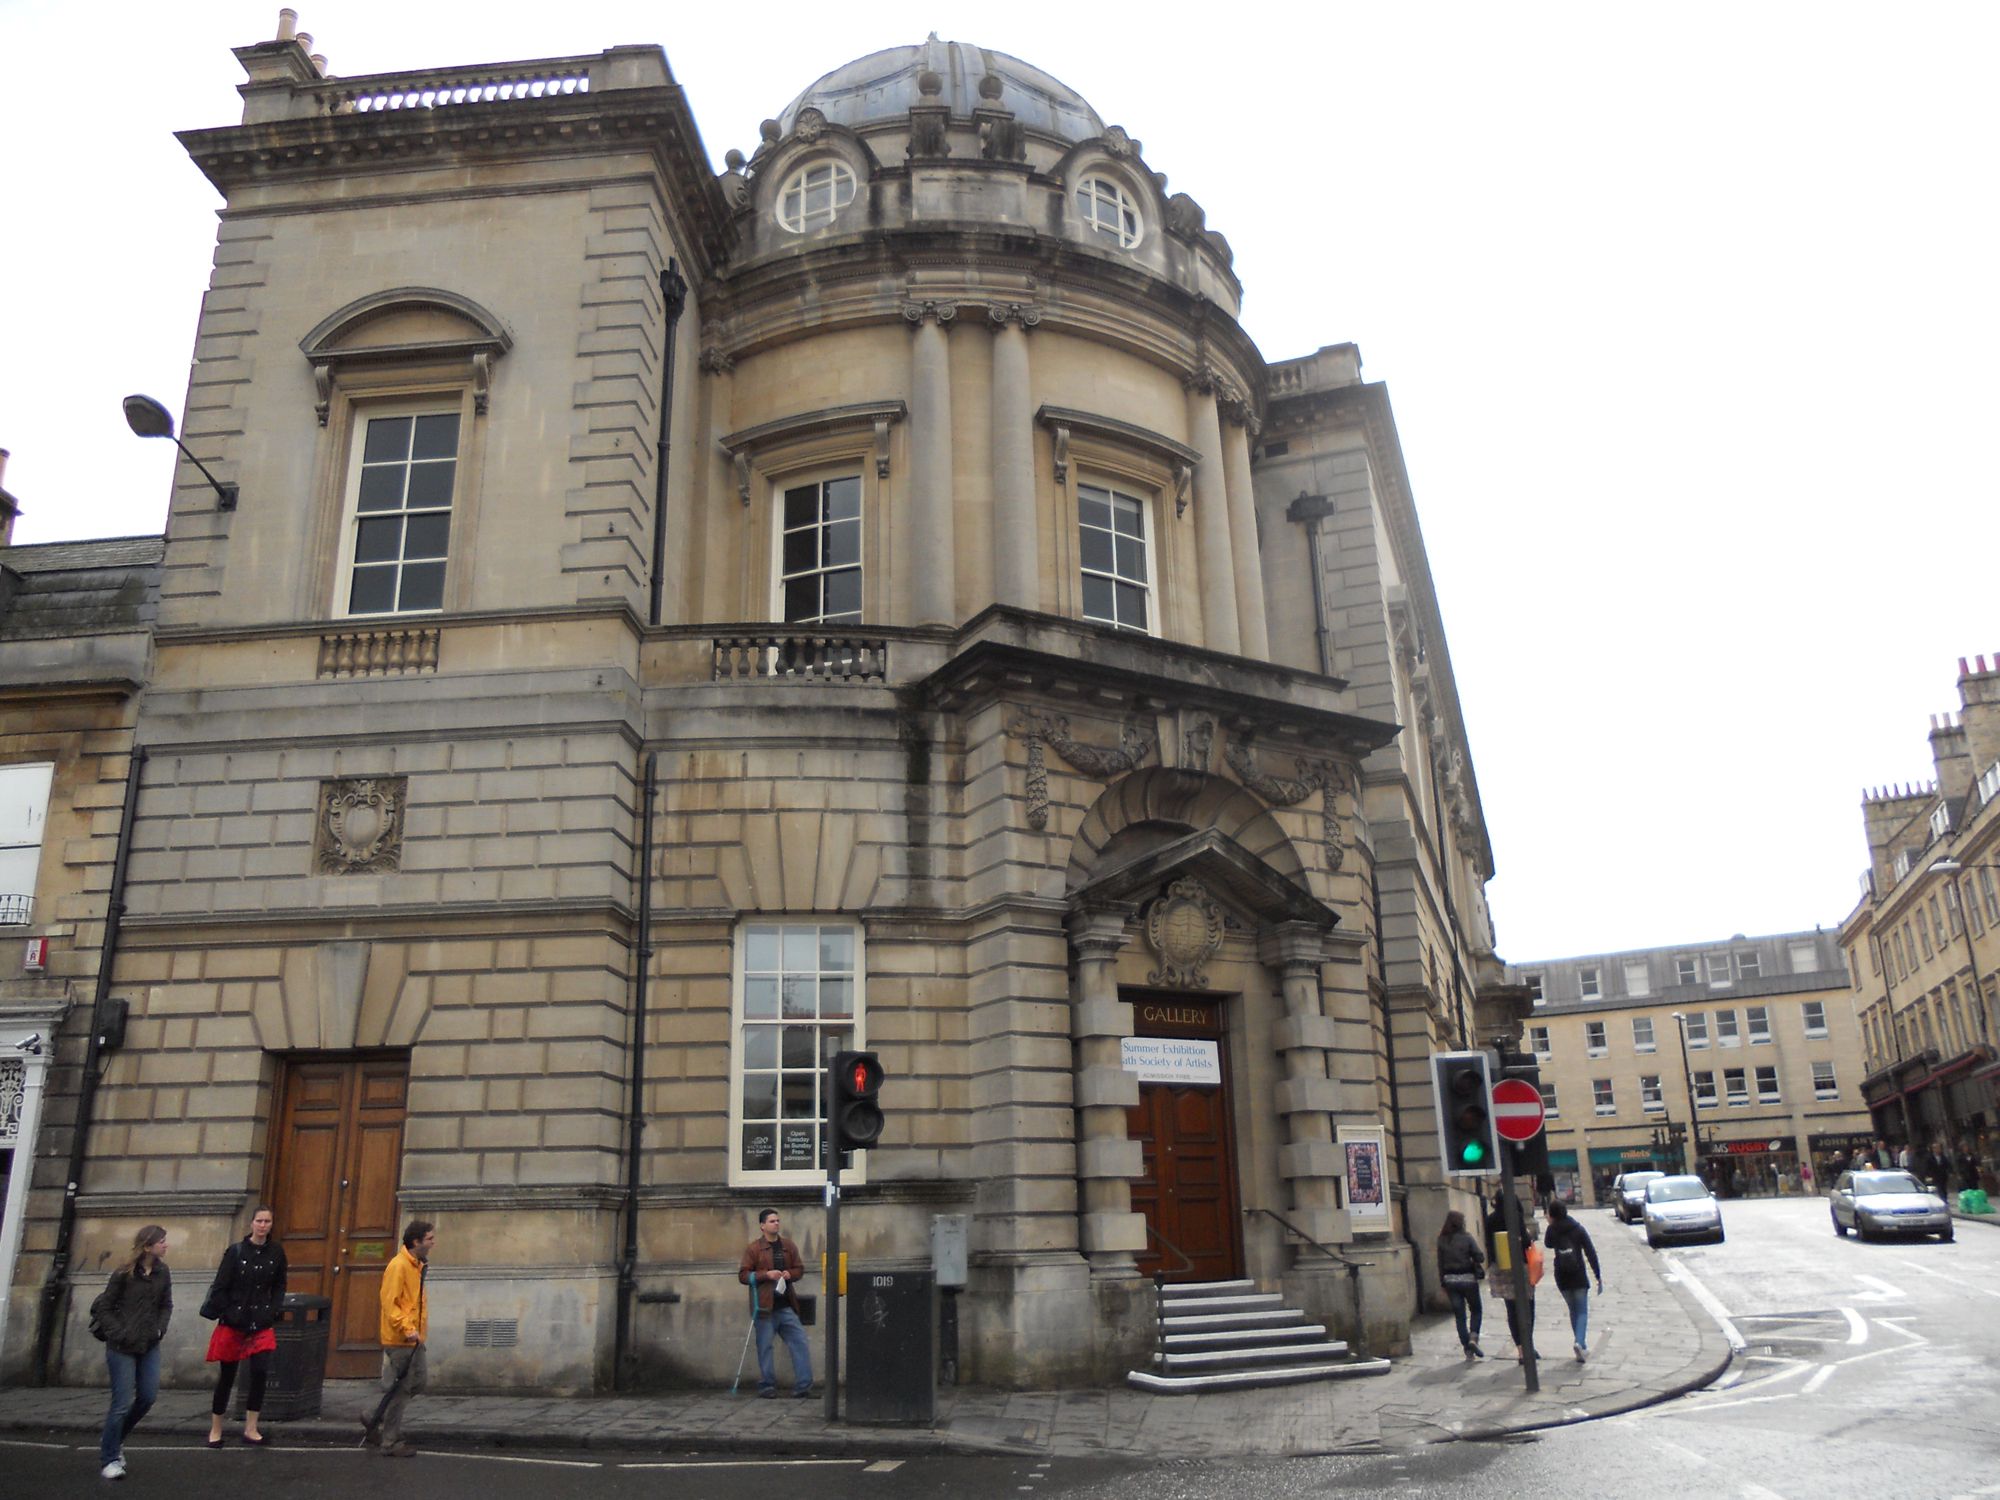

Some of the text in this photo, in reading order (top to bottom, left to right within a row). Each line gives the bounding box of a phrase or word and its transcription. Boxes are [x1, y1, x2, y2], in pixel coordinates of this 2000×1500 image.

[1144, 1006, 1207, 1025] GALLERY
[1123, 1042, 1206, 1055] Summer Exhibition
[1122, 1056, 1212, 1069] ath Society of Artists
[1817, 1137, 1848, 1147] JOHN
[872, 1276, 894, 1287] 1019
